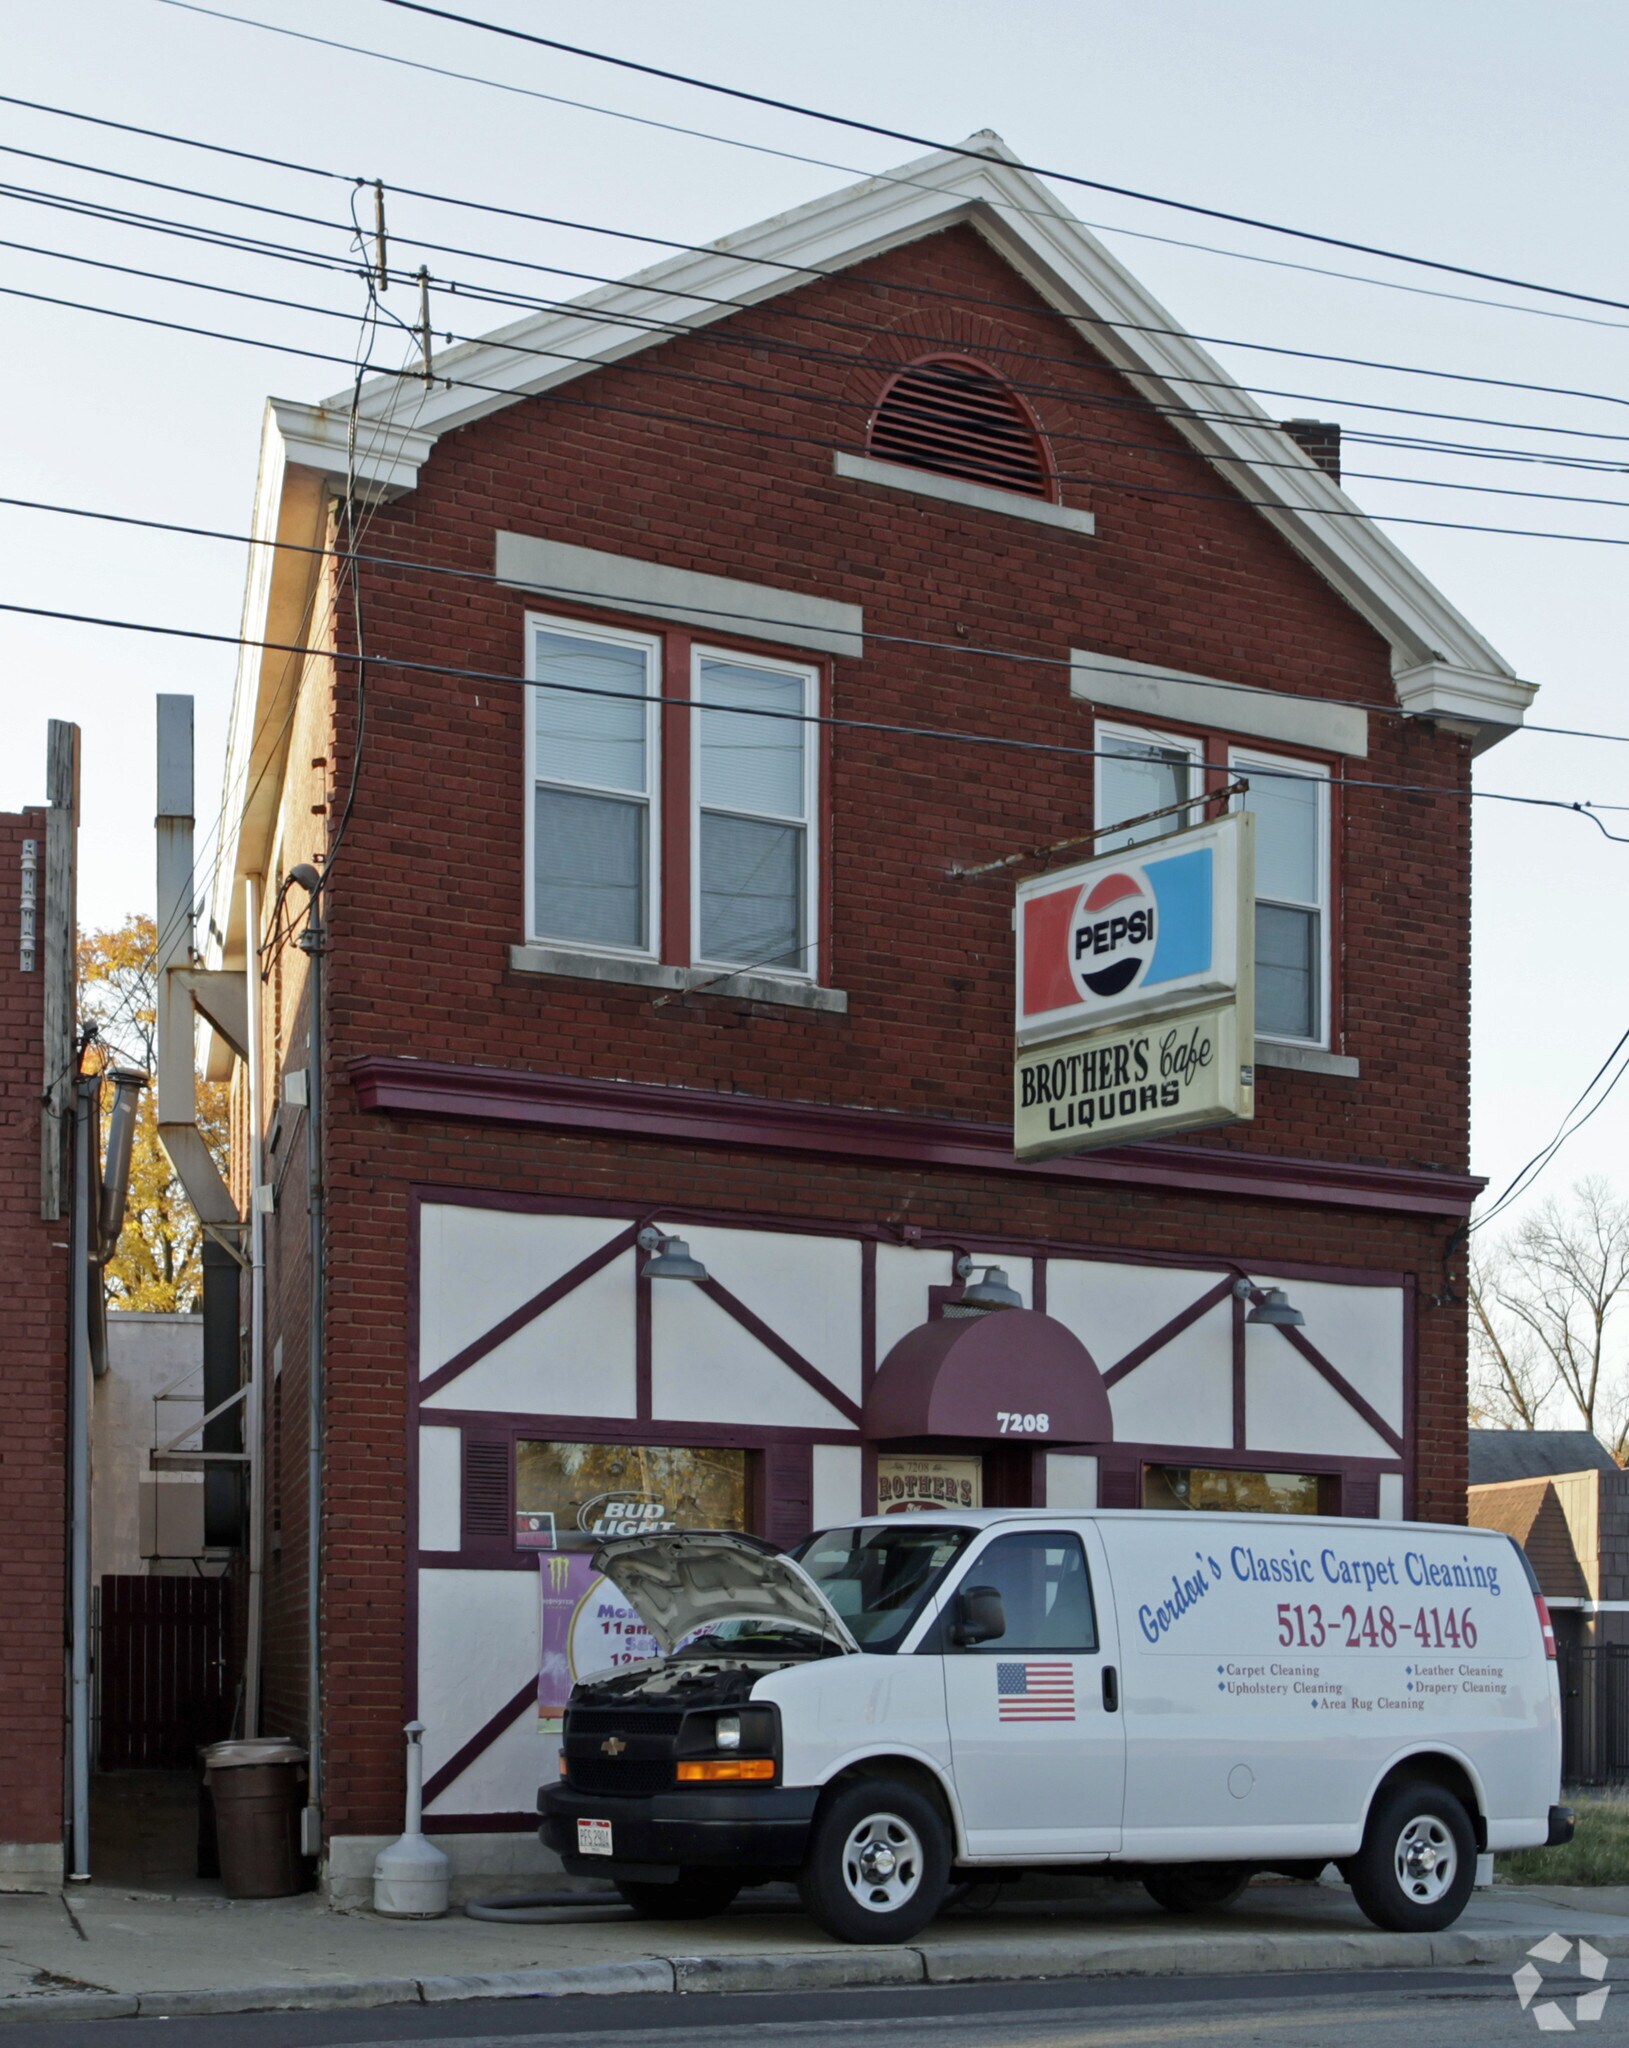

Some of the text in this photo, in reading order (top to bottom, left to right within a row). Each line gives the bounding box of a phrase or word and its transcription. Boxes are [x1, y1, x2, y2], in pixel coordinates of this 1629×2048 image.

[1075, 908, 1153, 960] PEPSI
[1021, 1026, 1213, 1108] BROTHER'S Cafe
[1049, 1080, 1180, 1131] LIQUORS
[996, 1411, 1050, 1433] 7208
[906, 1461, 930, 1473] 7208
[879, 1475, 972, 1507] ROTHER'S
[604, 1502, 665, 1519] BUD
[591, 1520, 676, 1536] LIGHT
[1138, 1546, 1501, 1644] Gordon's Classic Carpet Cleaning
[1277, 1603, 1478, 1649] 513-248-4146
[1226, 1663, 1320, 1678] Carpet Cleaning
[1414, 1664, 1503, 1678] Leather Cleaning
[1227, 1681, 1343, 1696] Upholstery Cleaning
[1415, 1681, 1507, 1695] Drapery Cleaning
[1321, 1697, 1425, 1711] Area Rug Cleaning
